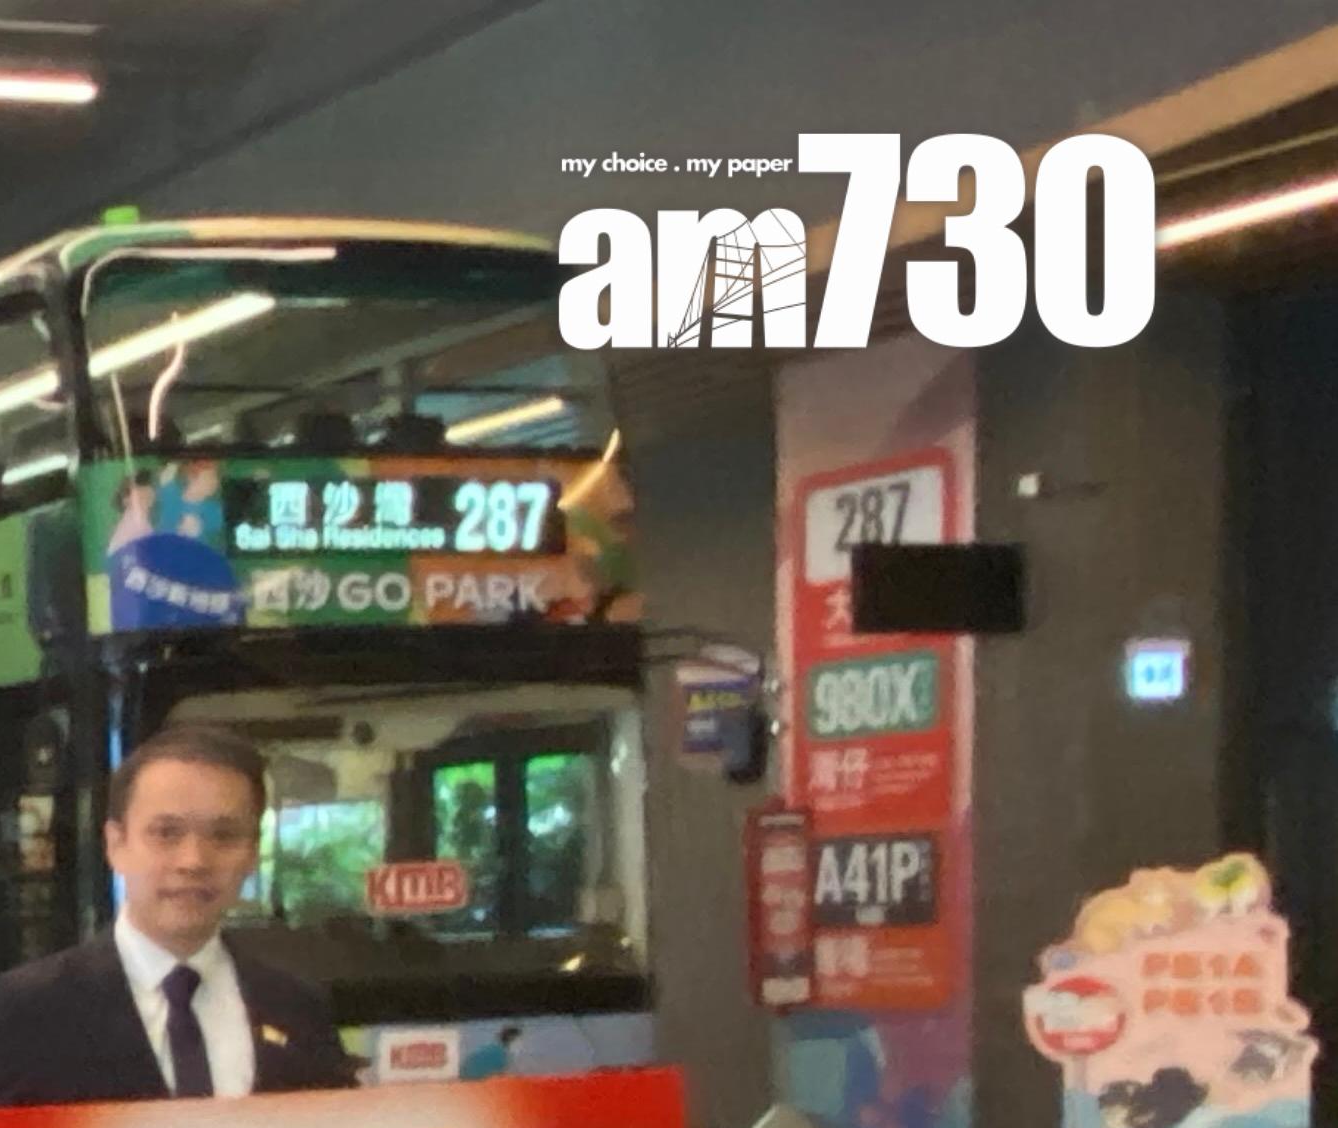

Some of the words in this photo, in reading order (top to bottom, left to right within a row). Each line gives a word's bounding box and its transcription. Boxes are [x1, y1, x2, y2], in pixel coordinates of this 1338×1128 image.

[454, 481, 550, 551] 287
[835, 482, 911, 555] 287
[425, 573, 550, 612] PARK
[815, 658, 921, 734] 980X
[813, 841, 920, 905] A41P
